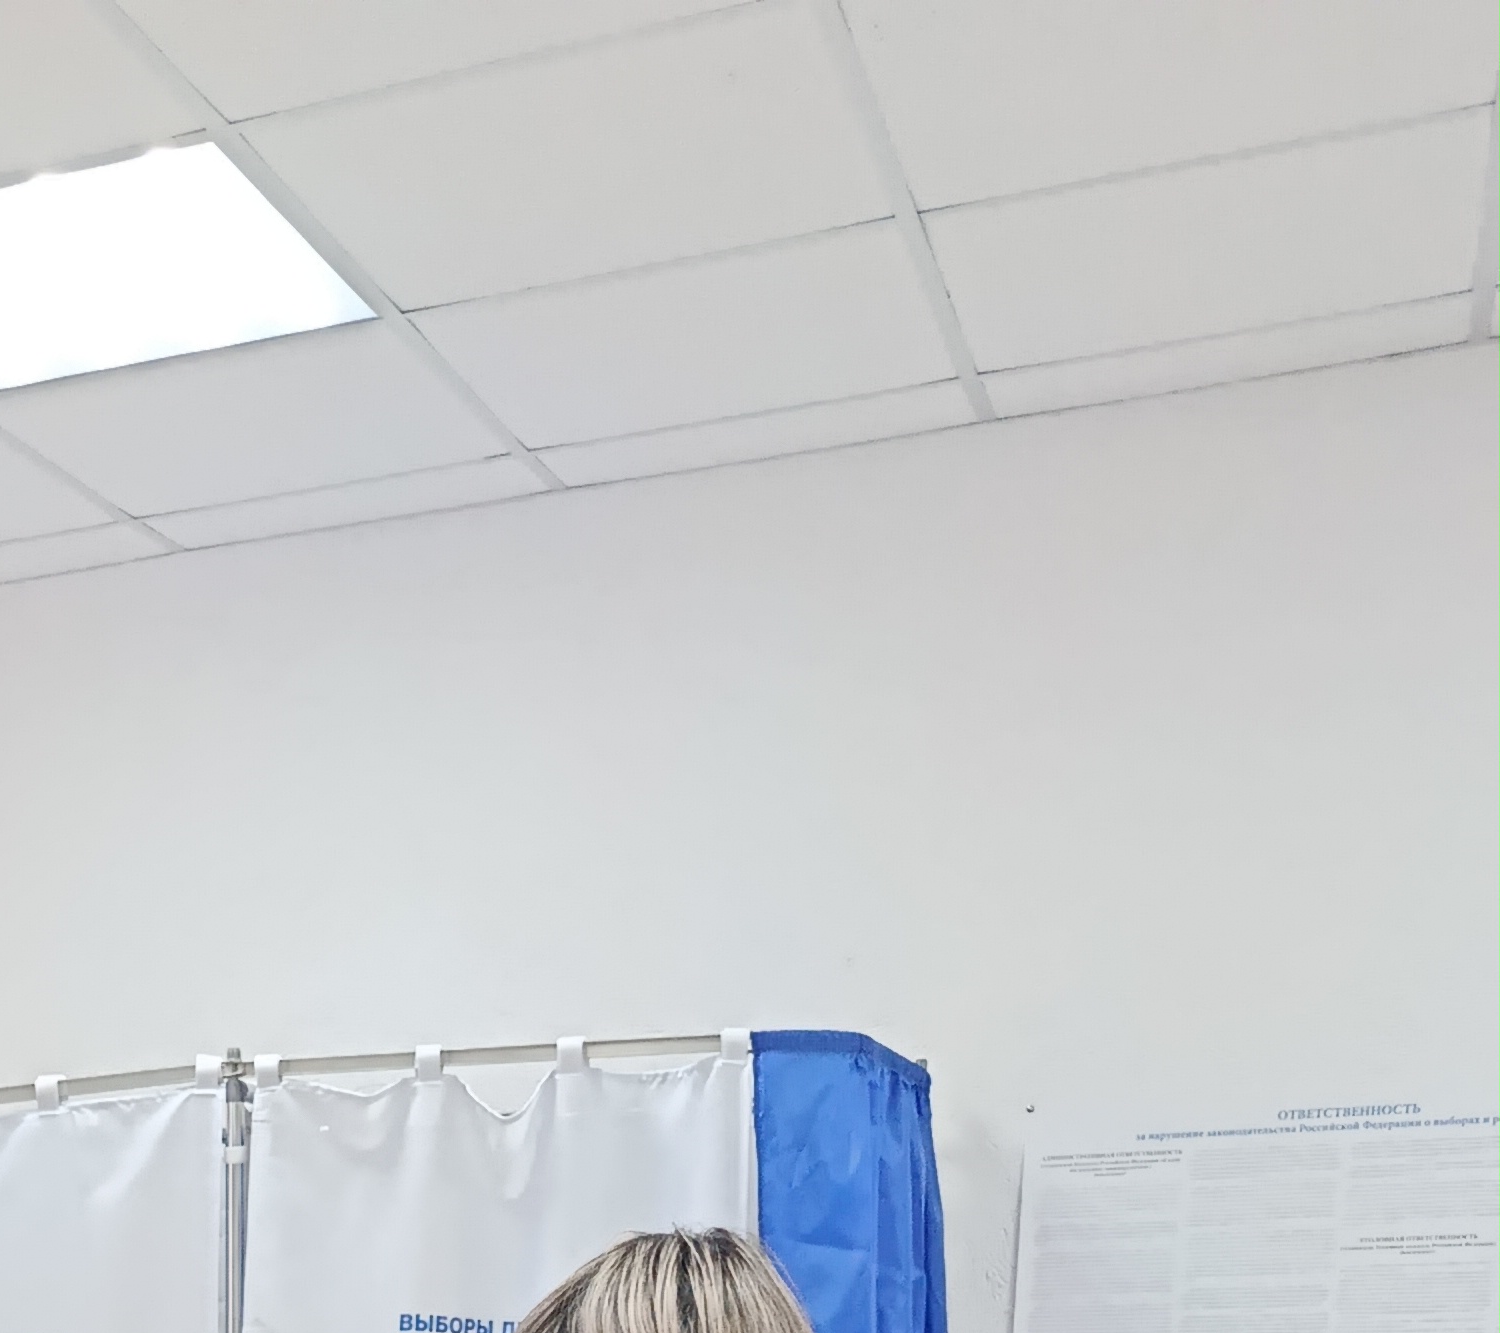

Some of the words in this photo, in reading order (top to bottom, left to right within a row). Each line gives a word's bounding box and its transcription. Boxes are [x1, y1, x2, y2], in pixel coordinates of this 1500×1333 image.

[1277, 1104, 1421, 1120] ОТВЕТСТВЕННОСТЬ
[1207, 1127, 1296, 1136] законодательства
[1300, 1122, 1359, 1132] Российской
[1363, 1121, 1421, 1130] Федерации
